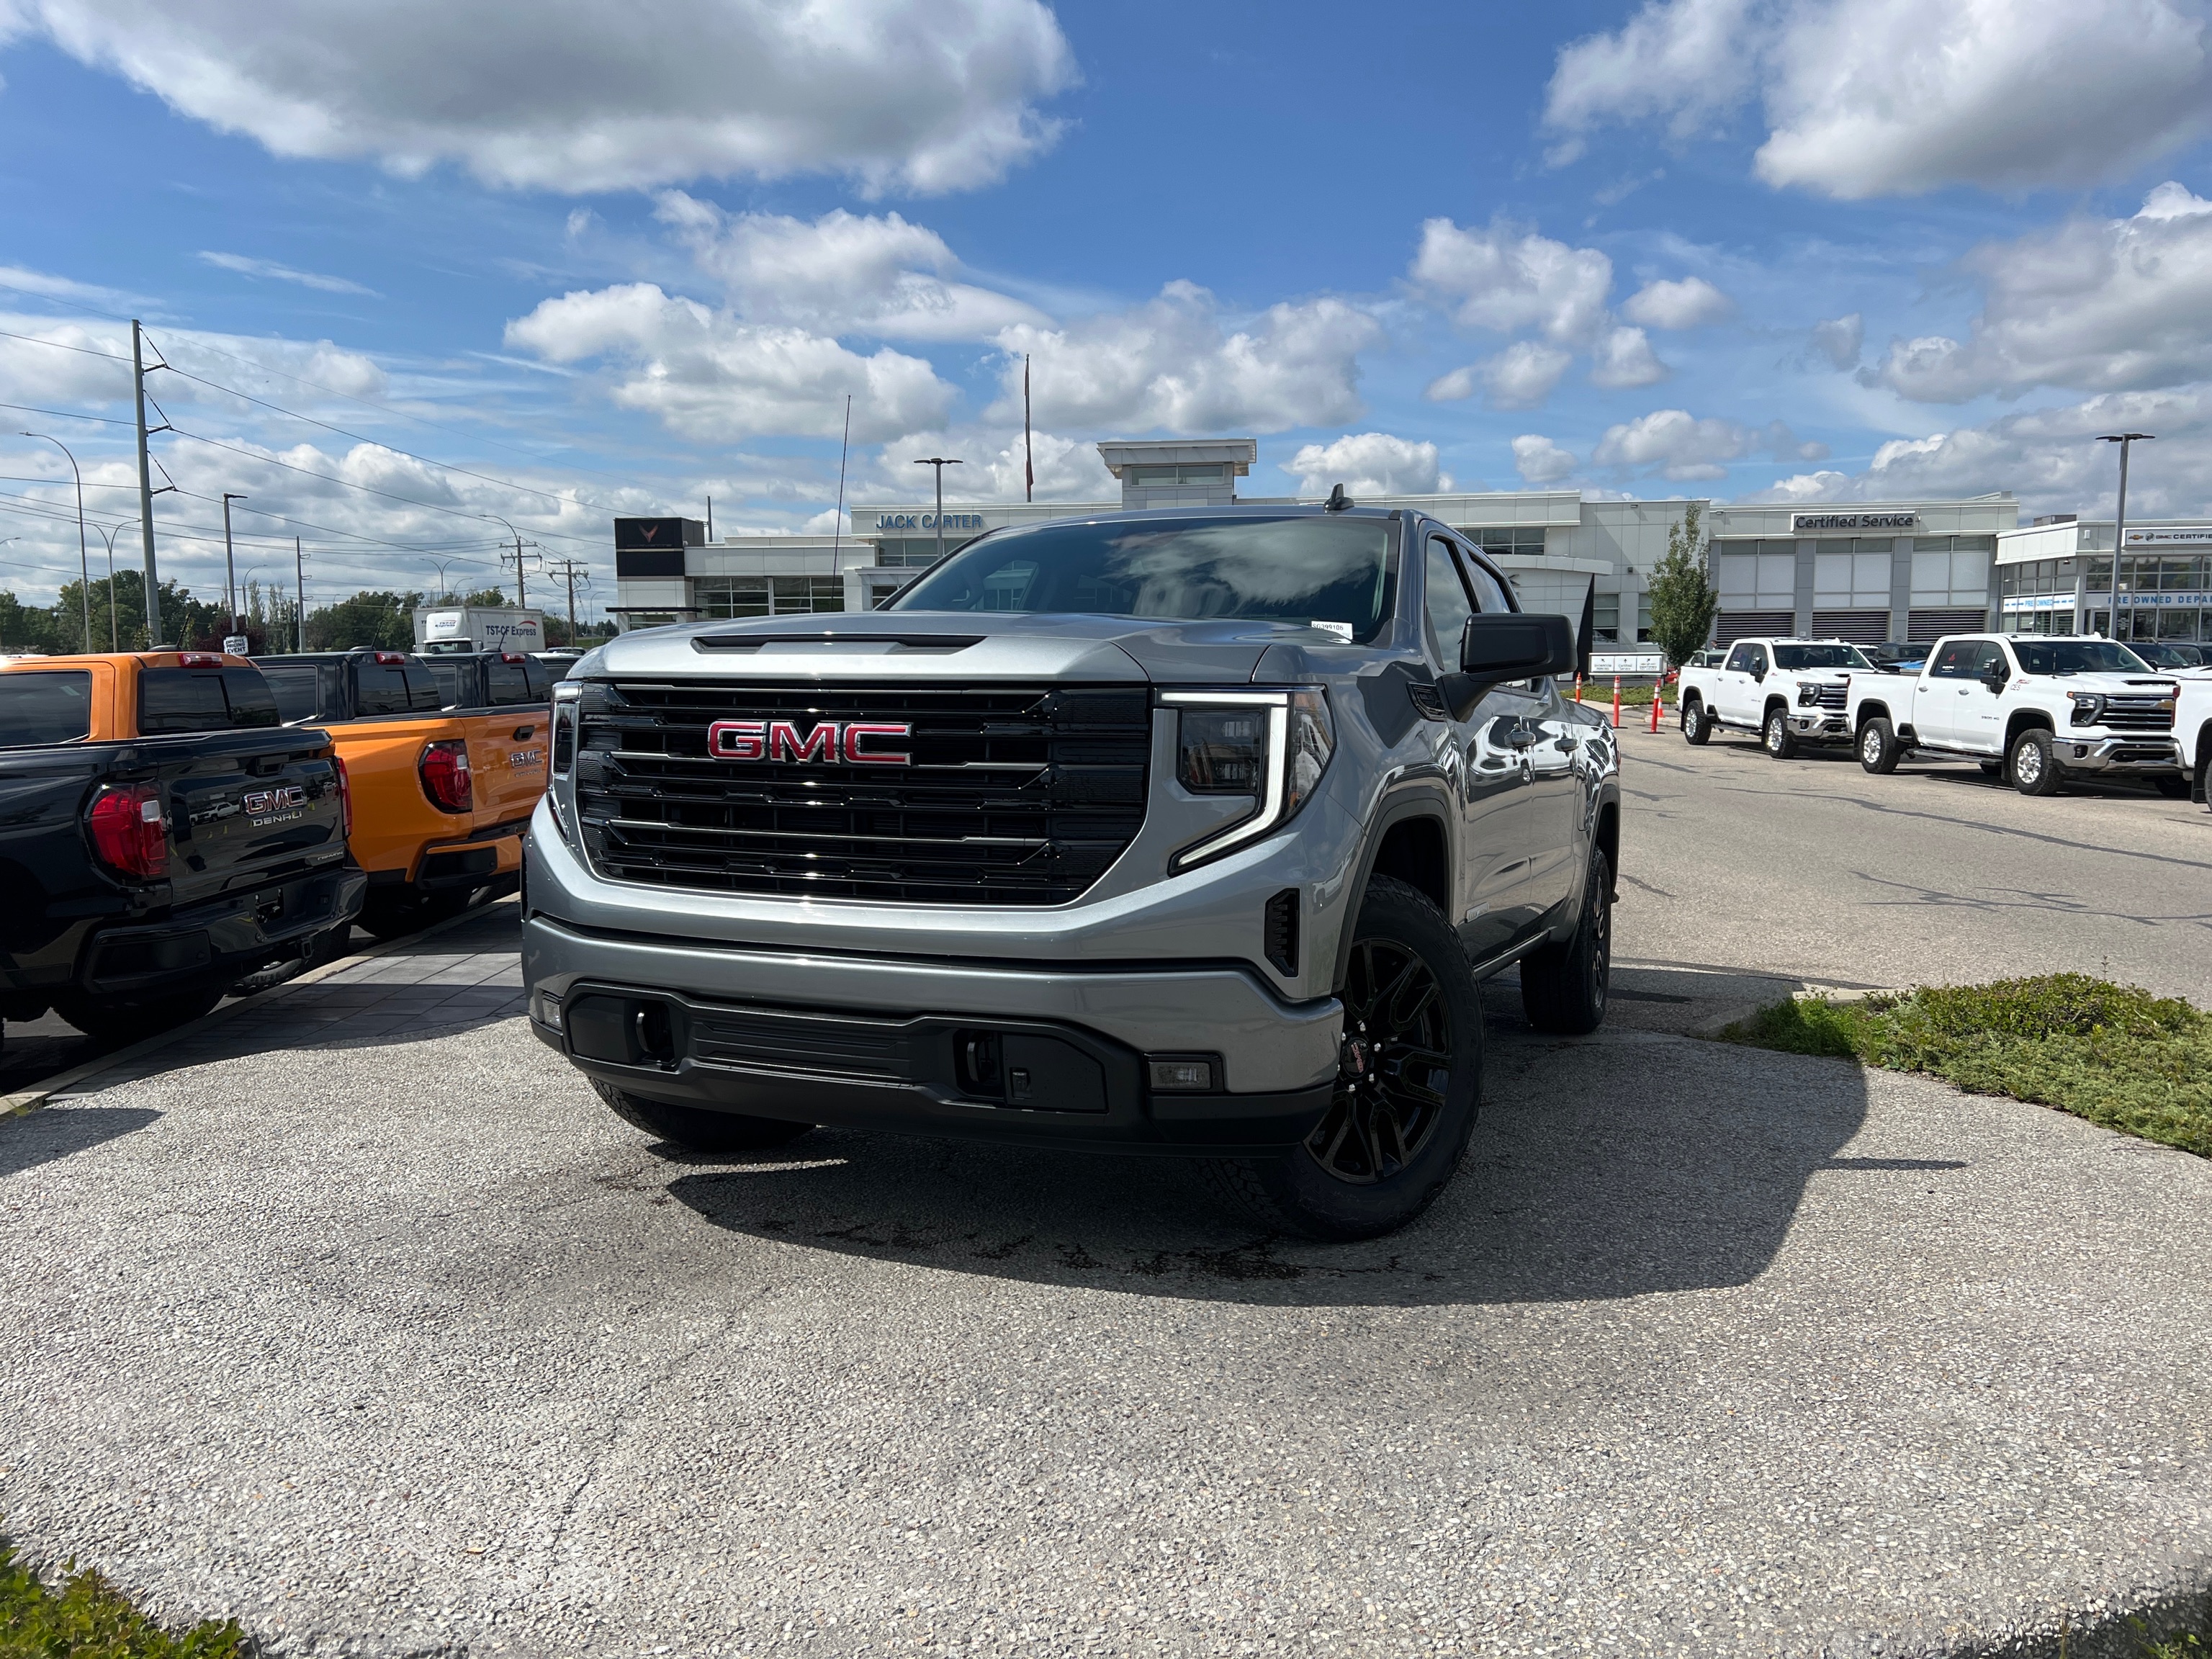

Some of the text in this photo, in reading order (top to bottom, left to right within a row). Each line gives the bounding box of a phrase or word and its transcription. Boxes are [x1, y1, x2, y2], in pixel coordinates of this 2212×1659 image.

[876, 515, 917, 529] JACK
[1796, 514, 1913, 528] Certified Service
[2134, 595, 2172, 604] OWNED
[485, 625, 536, 637] TST-CF Express
[708, 720, 912, 765] GMC
[511, 750, 544, 768] GMC
[245, 786, 307, 815] GMC
[252, 811, 302, 827] DENALI
[1351, 1042, 1364, 1073] GMC
